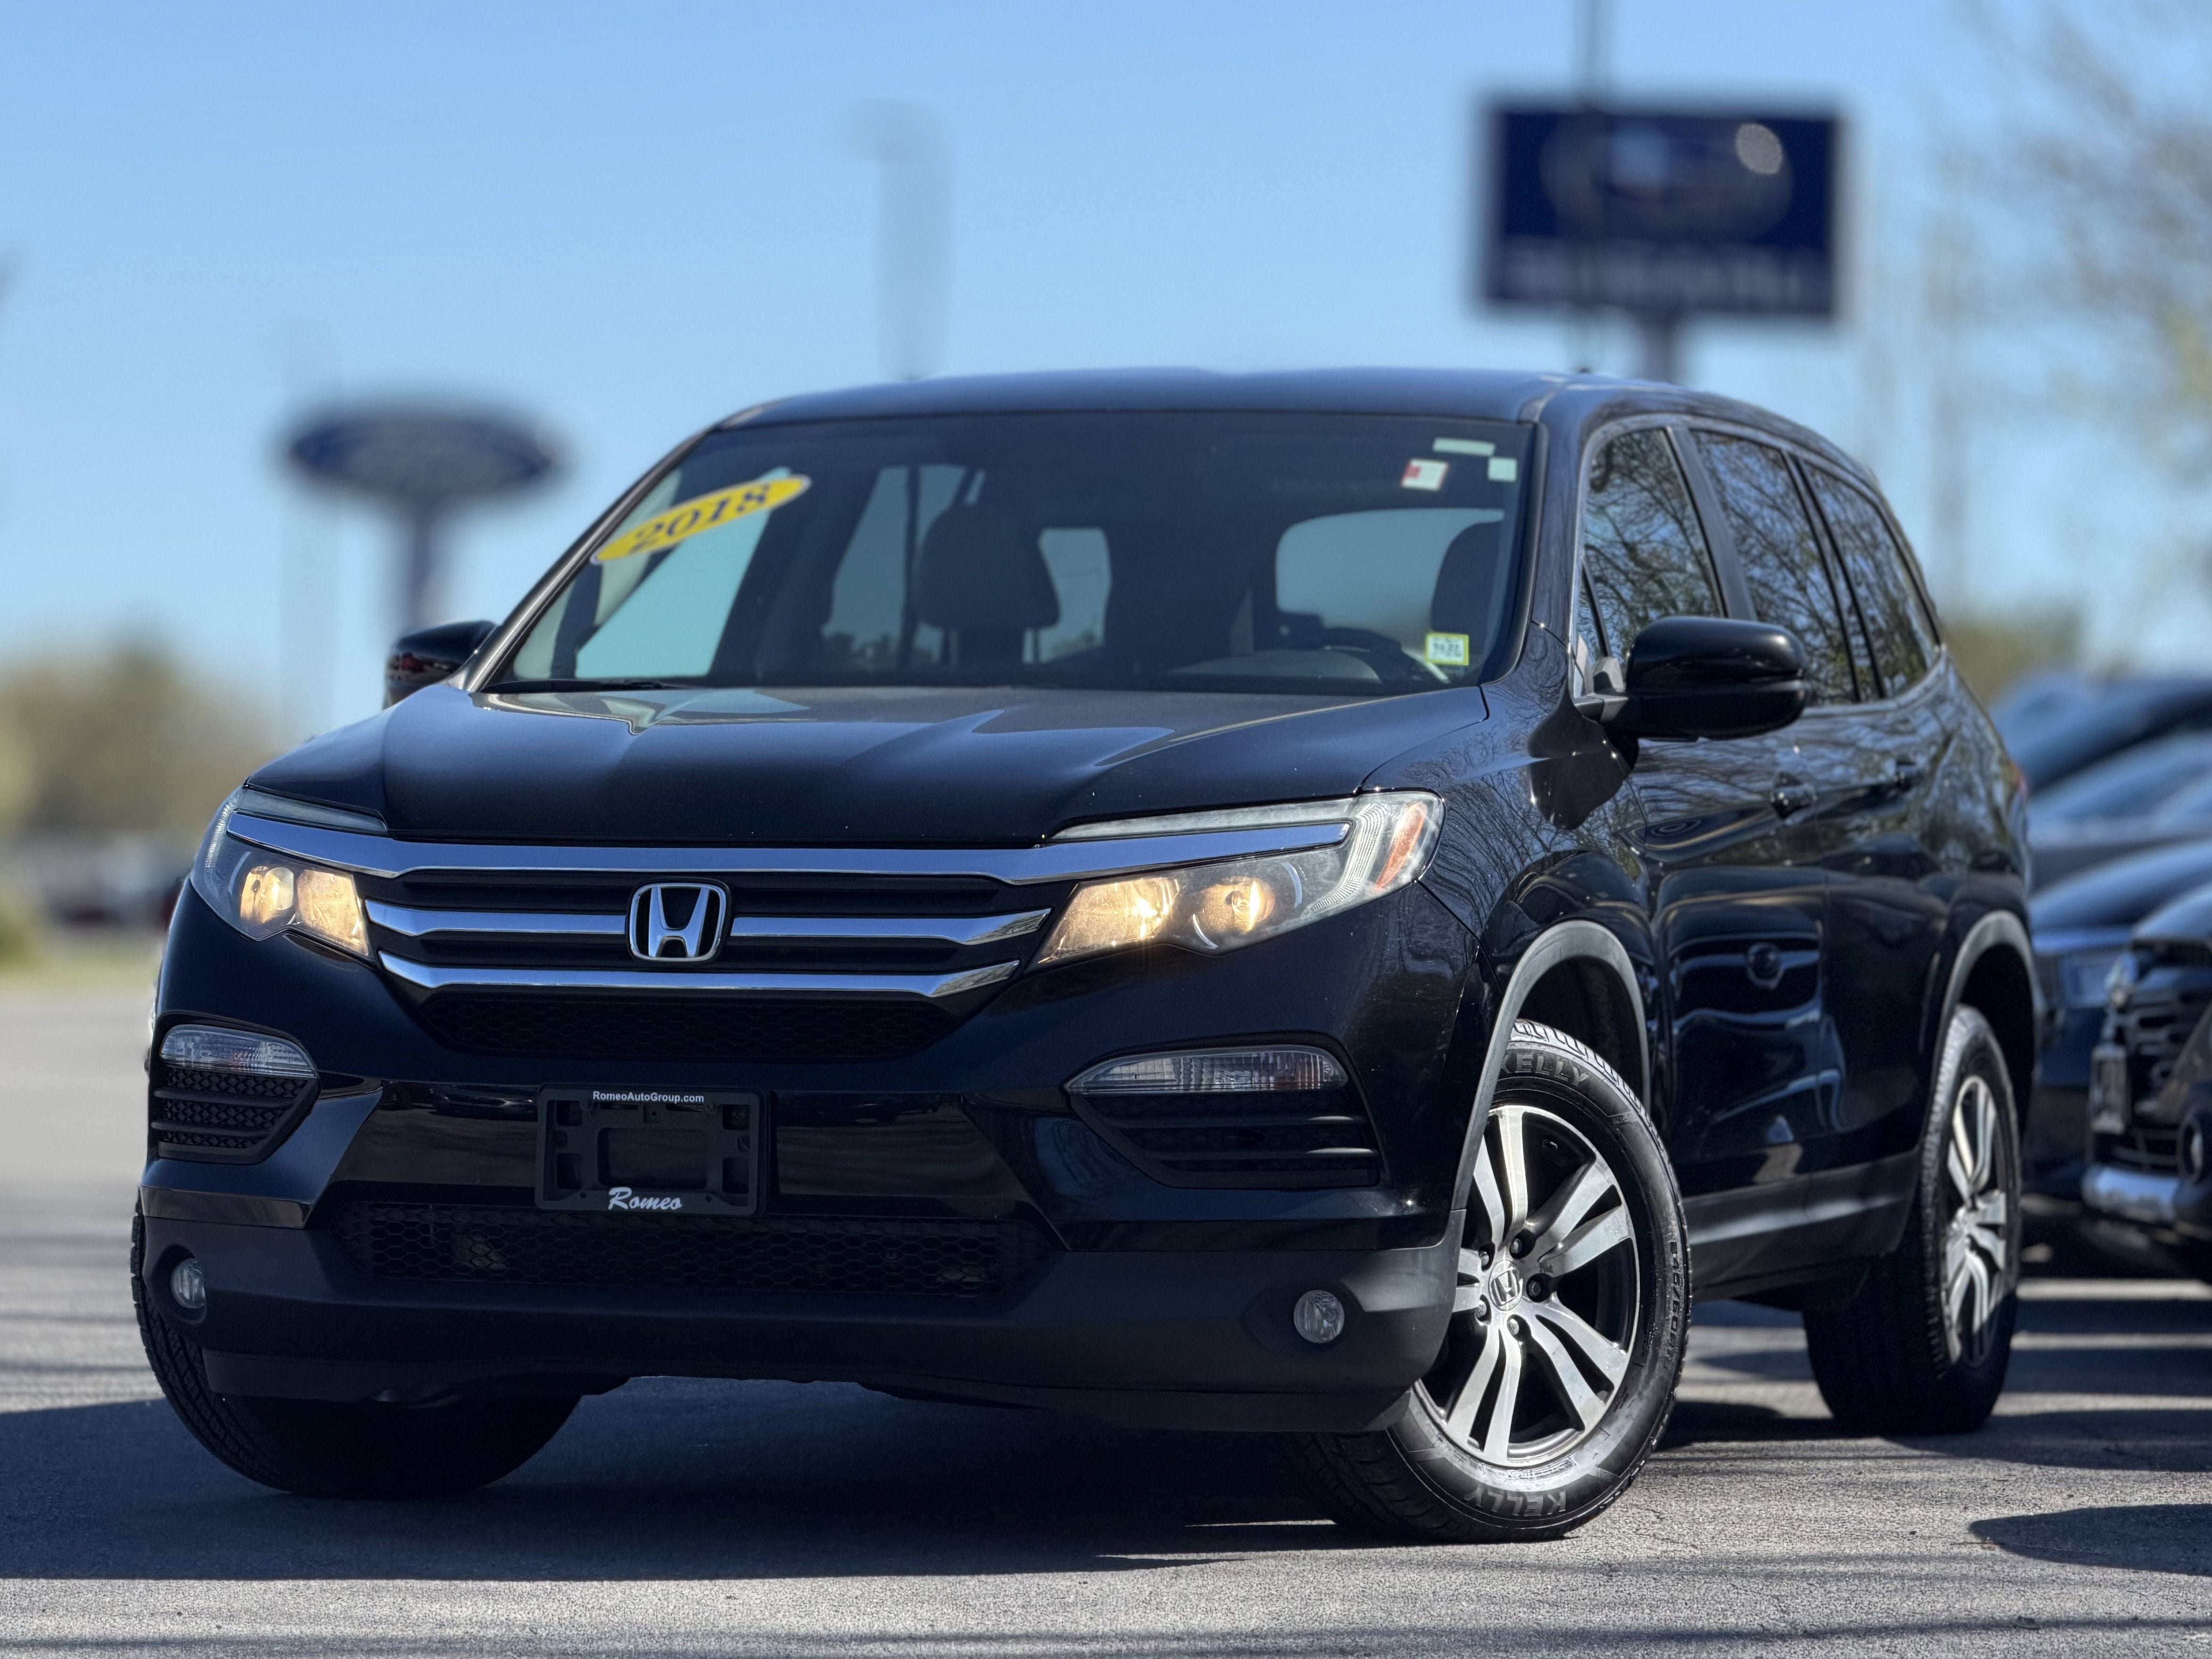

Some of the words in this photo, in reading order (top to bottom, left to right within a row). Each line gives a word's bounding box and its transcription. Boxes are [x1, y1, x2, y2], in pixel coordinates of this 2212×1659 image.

[630, 484, 771, 551] 2018
[593, 1091, 705, 1104] RomeoAutoGroup.com
[608, 1187, 682, 1210] Romeo
[1464, 1487, 1566, 1516] KELLY
